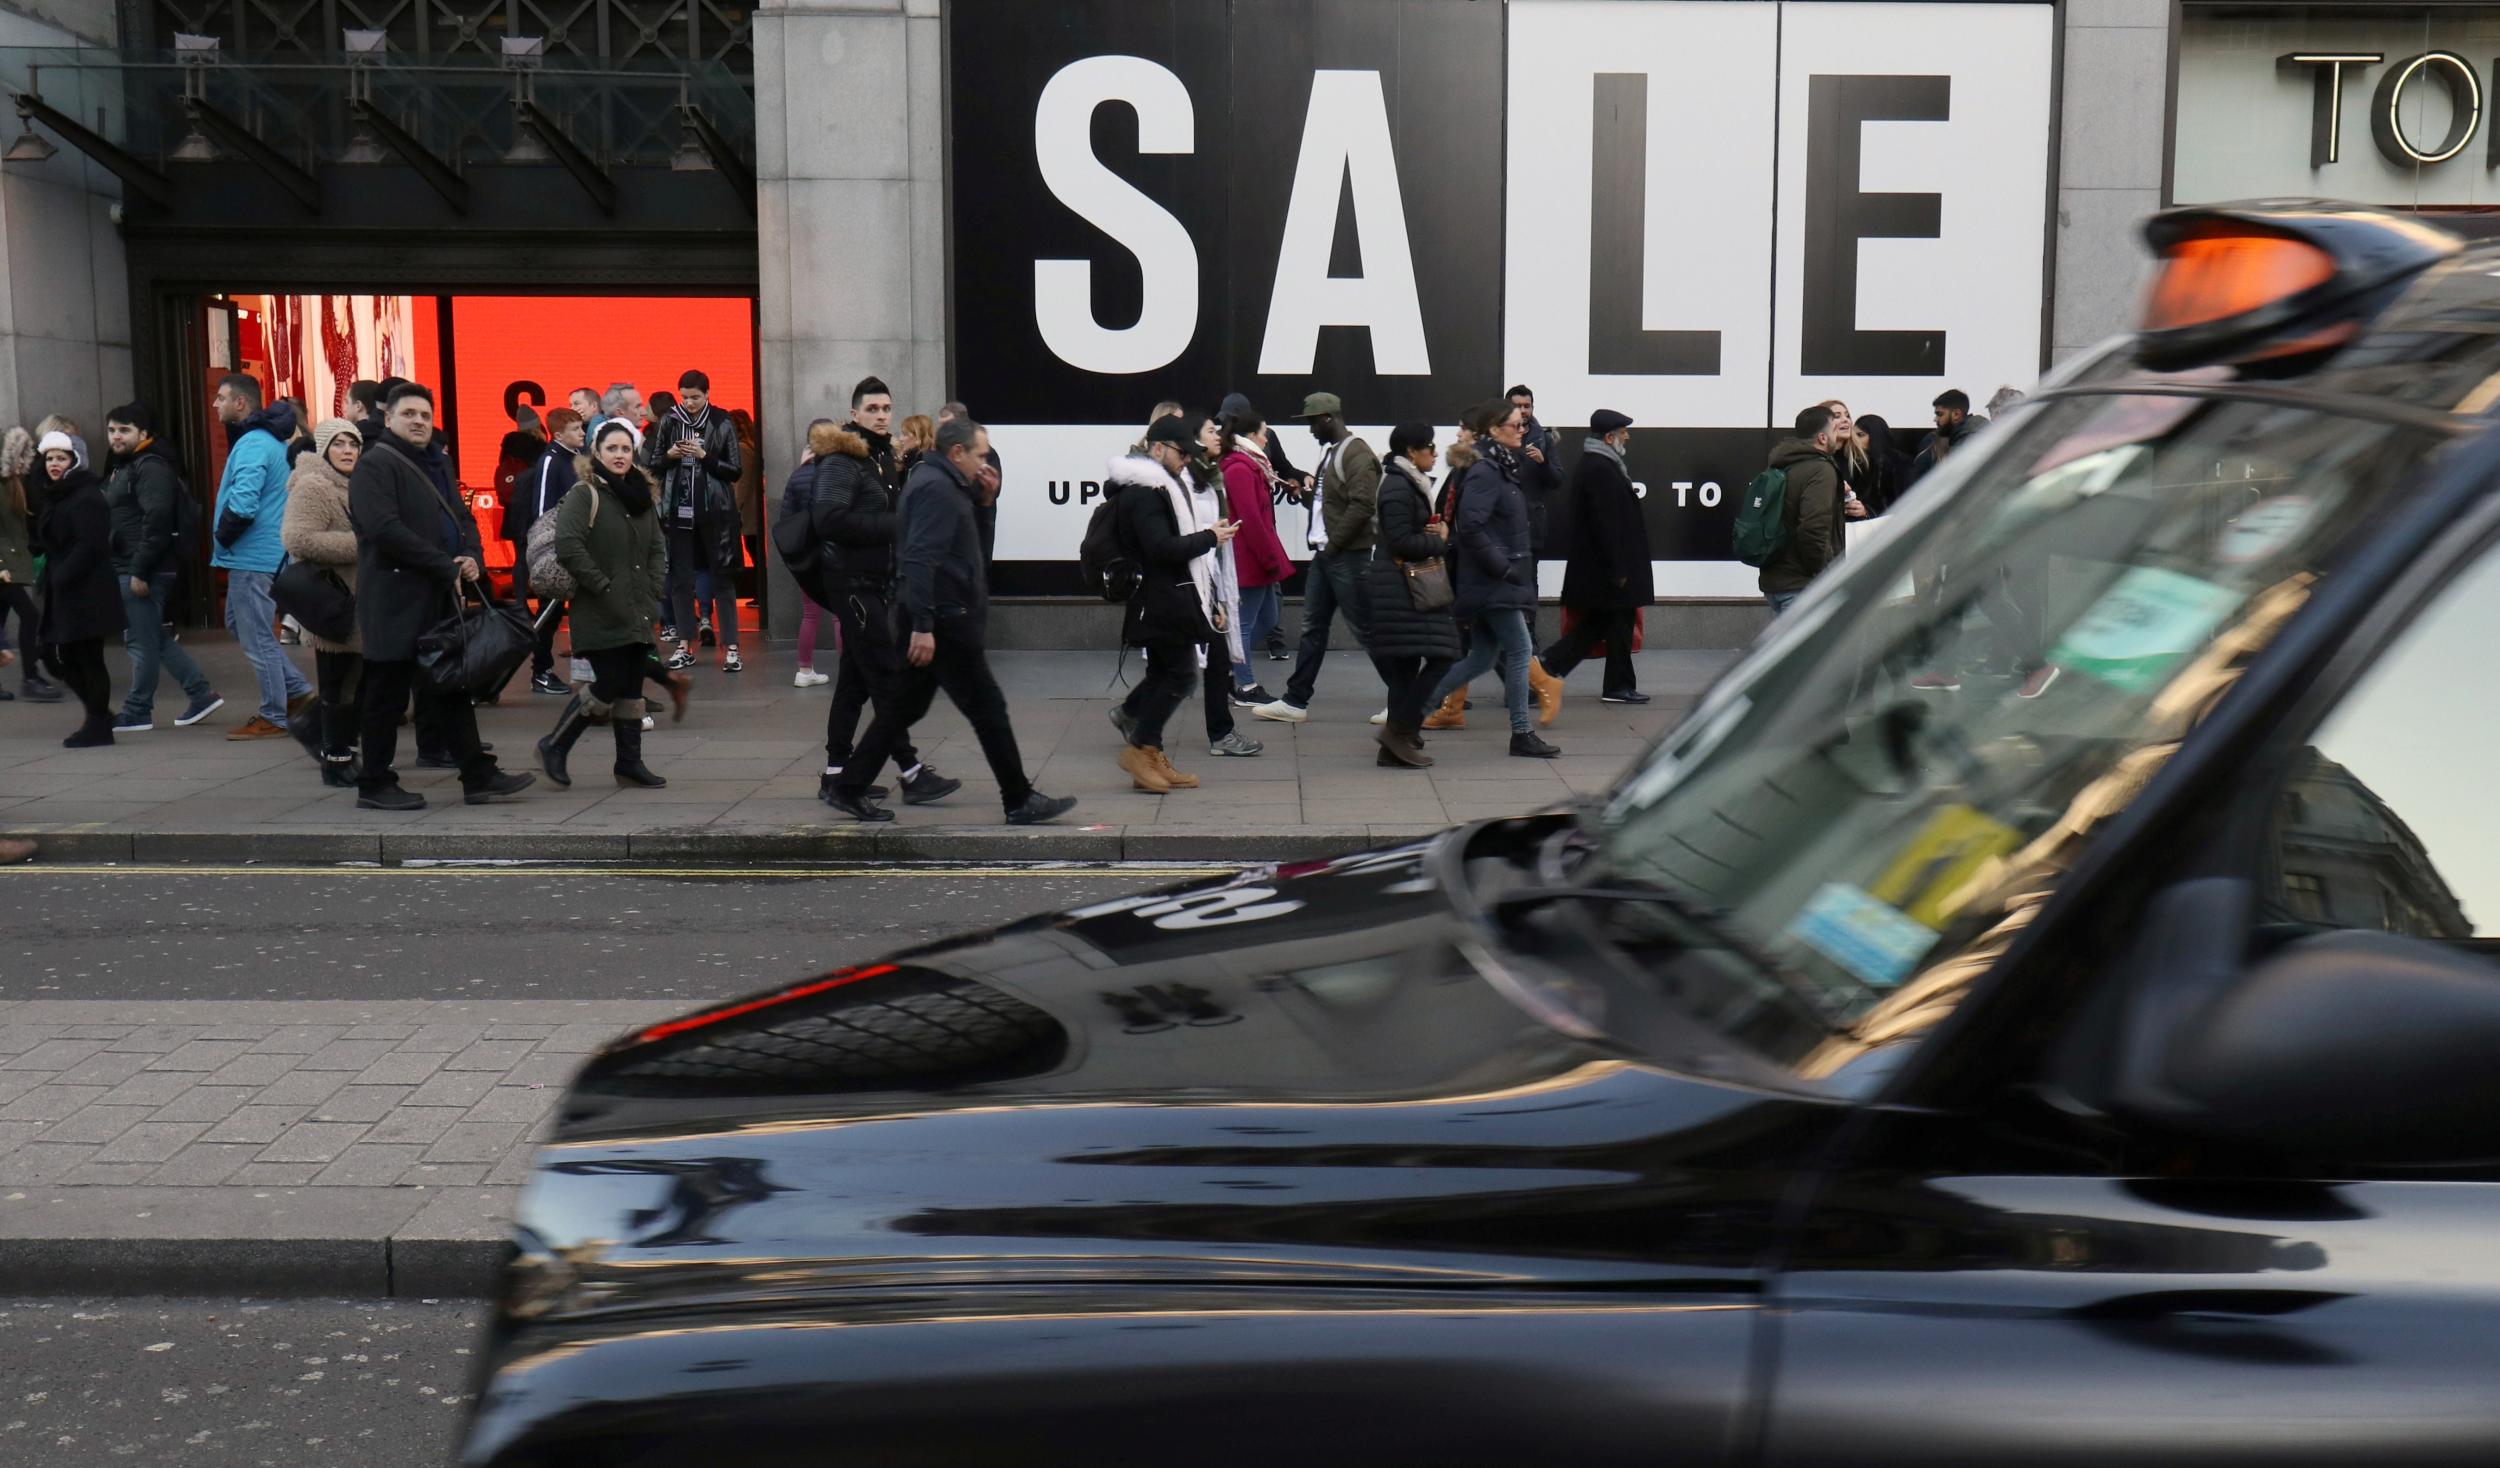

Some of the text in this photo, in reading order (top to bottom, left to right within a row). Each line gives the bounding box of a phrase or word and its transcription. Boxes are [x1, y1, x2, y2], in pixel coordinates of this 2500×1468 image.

[2276, 50, 2500, 170] TO
[1034, 54, 1950, 377] SALE
[1048, 481, 1100, 505] UP
[1671, 481, 1722, 507] TO
